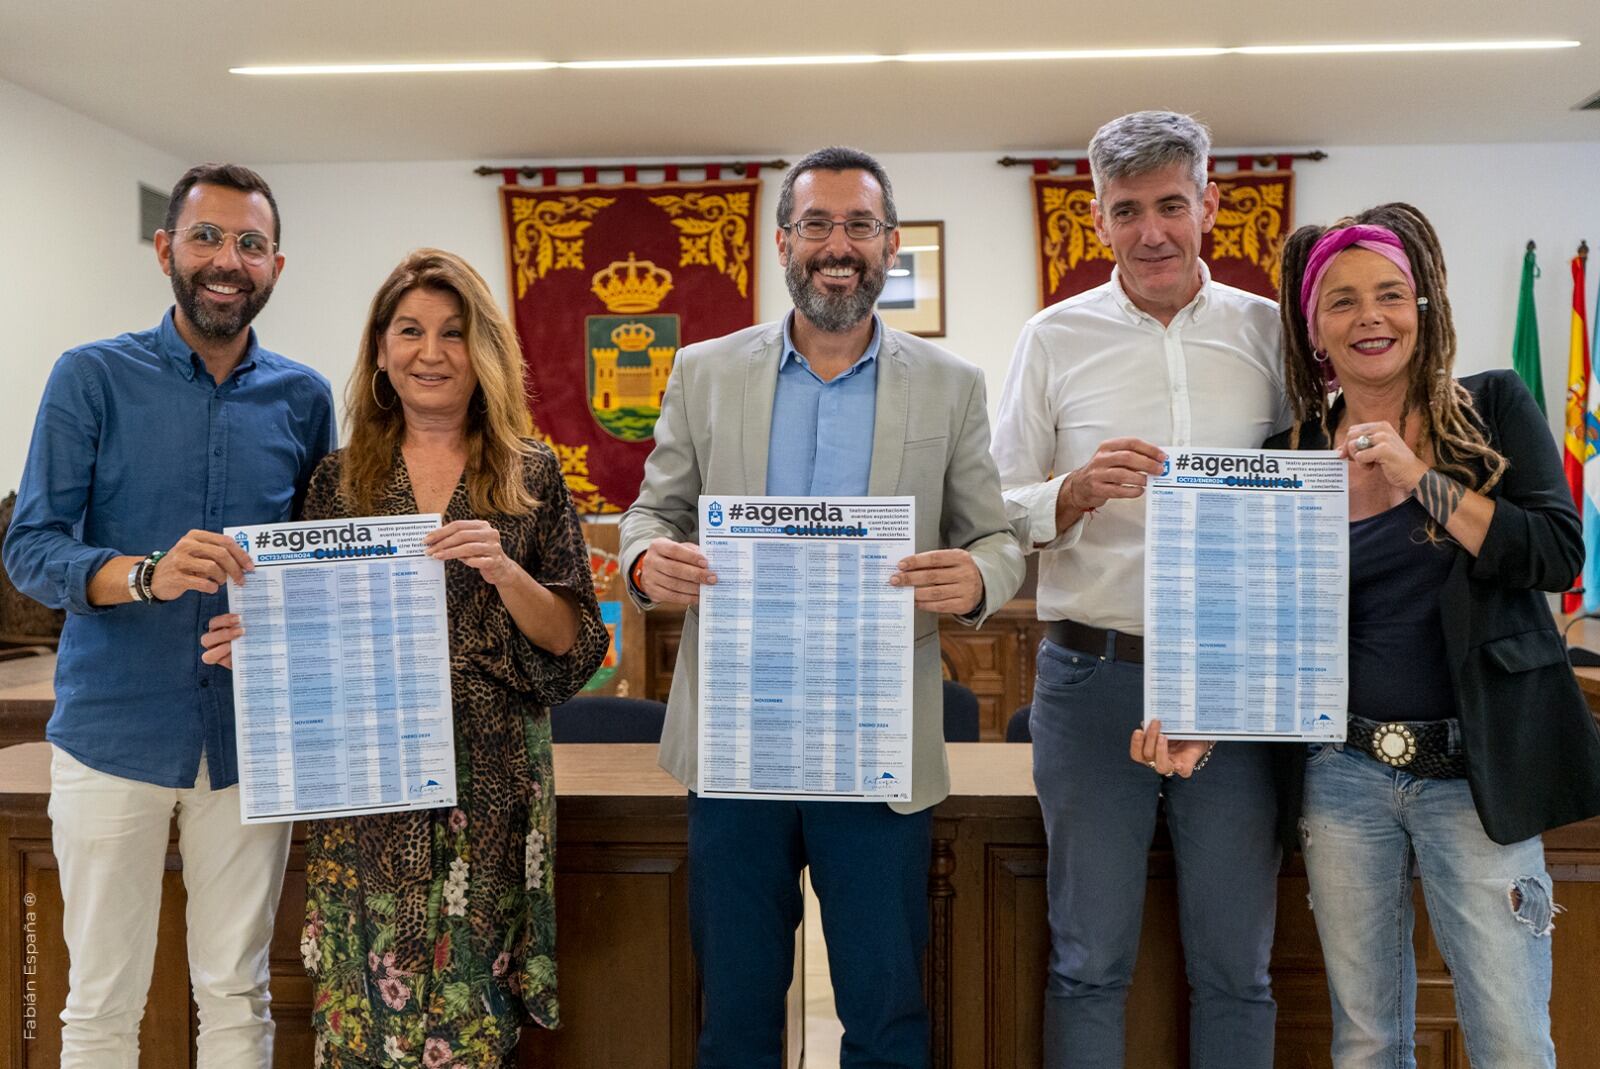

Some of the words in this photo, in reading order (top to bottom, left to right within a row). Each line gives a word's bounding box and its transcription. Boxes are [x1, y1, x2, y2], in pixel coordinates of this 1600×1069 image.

[1176, 454, 1280, 476] #agenda
[1226, 474, 1300, 489] cultural
[728, 502, 843, 526] #agenda
[256, 523, 372, 552] #agenda
[784, 522, 866, 538] cultural
[314, 540, 395, 560] cultural
